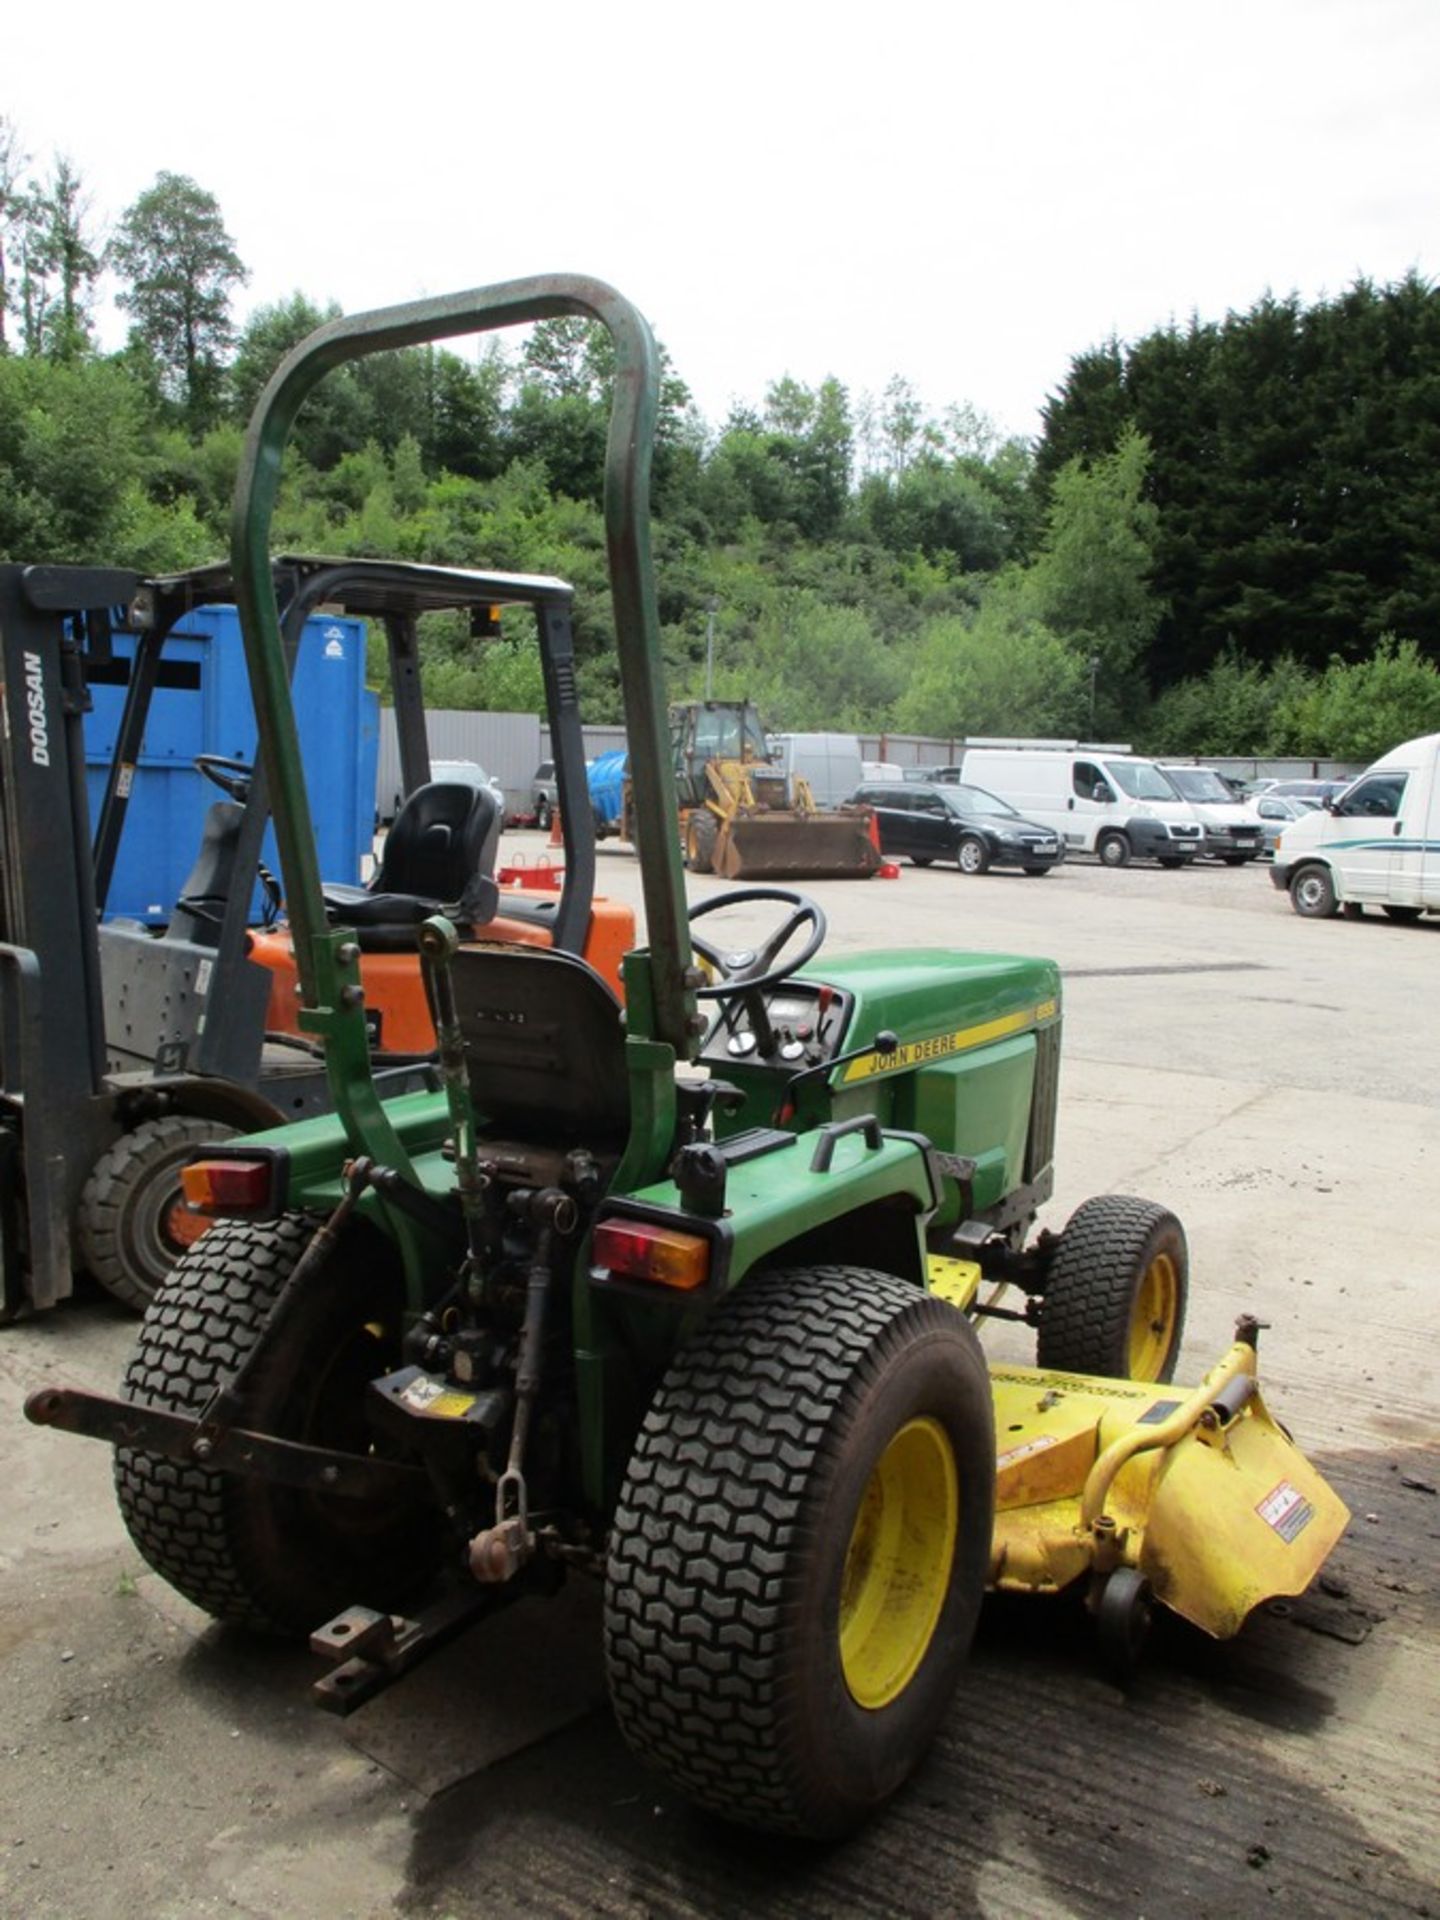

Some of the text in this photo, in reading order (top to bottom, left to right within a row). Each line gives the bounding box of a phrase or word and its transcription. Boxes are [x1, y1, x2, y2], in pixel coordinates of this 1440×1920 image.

[24, 651, 50, 766] DOOSAN
[870, 1033, 956, 1073] JOHN DEERE
